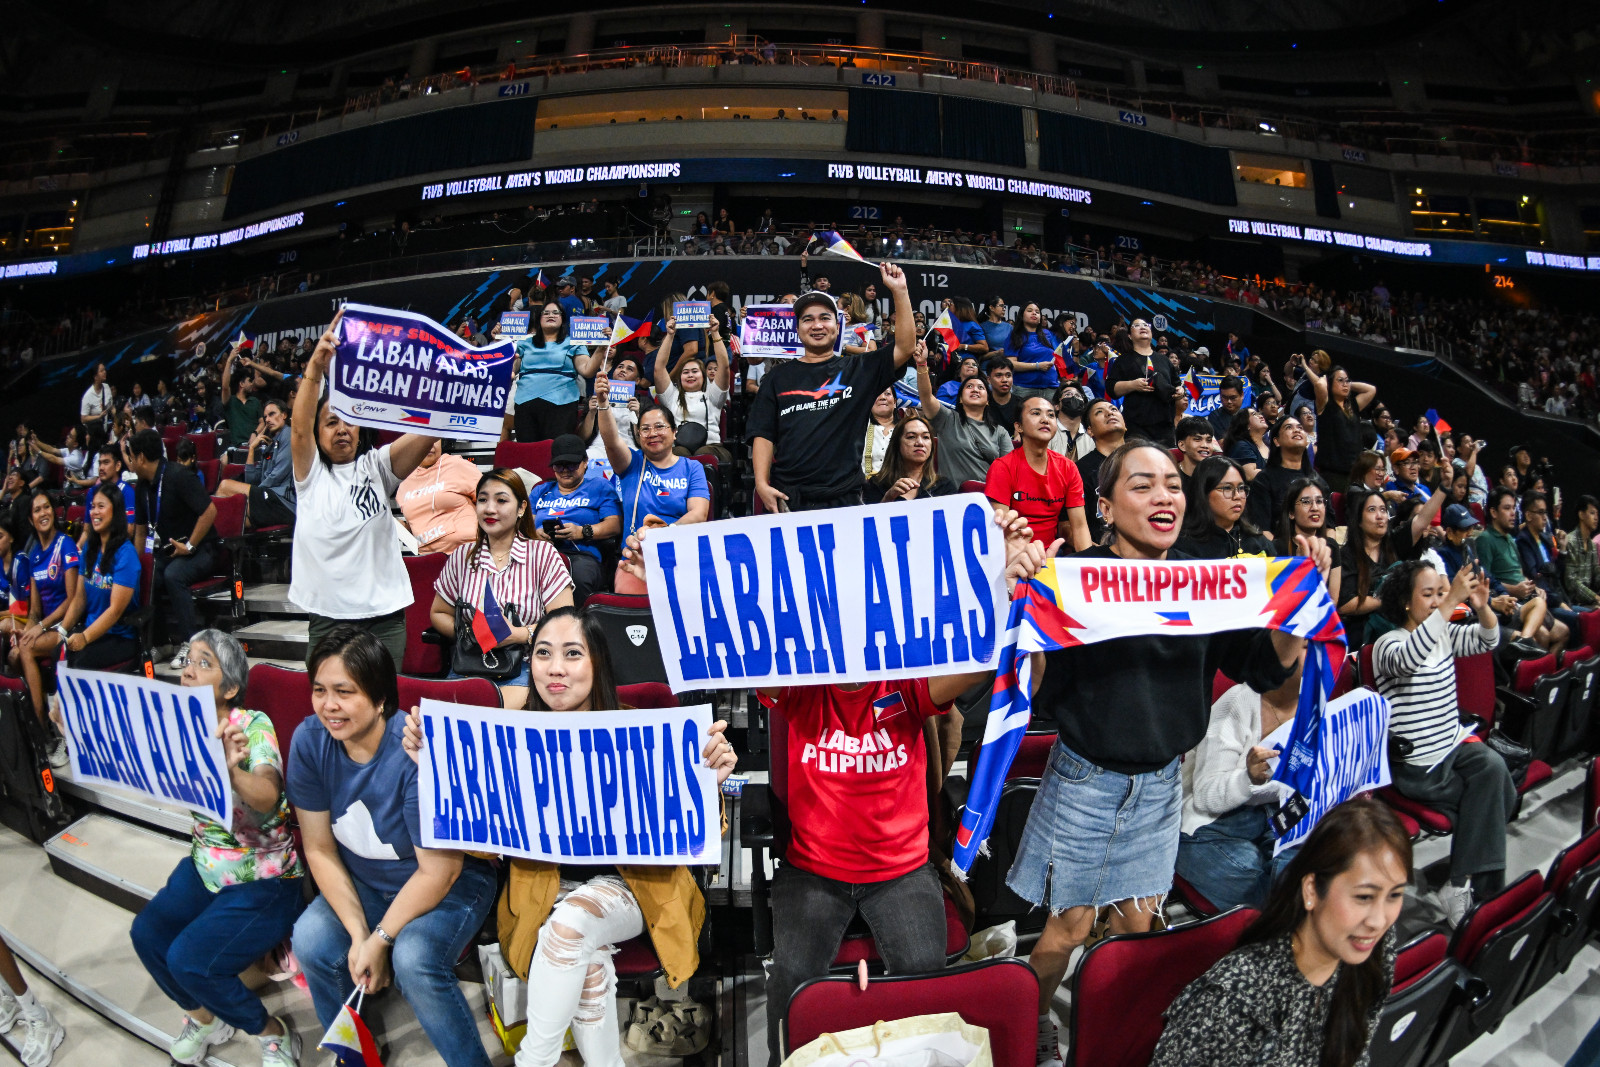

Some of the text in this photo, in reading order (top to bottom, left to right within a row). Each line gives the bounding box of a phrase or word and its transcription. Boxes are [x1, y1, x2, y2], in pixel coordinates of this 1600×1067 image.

[503, 82, 525, 95] 411
[866, 74, 892, 86] 412
[1122, 112, 1144, 126] 413
[278, 131, 298, 145] 410
[422, 163, 681, 200] FIVB VOLLEYBALL MEN'S WORLD CHAMPIONSHIPS
[828, 164, 1092, 204] FIVB VOLLEYBALL MEN'S WORLD CHAMPIONSHIPS
[851, 206, 879, 219] 212
[192, 235, 219, 250] MEN'S
[220, 228, 244, 245] WORLD
[244, 212, 304, 239] CHAMPIONSHIPS
[1228, 219, 1432, 257] FIVB VOLLEYBALL MEN'S WORLD CHAMPIONSHIPS
[1118, 235, 1139, 250] 213
[279, 250, 297, 264] 210
[920, 273, 949, 288] 112
[1494, 275, 1515, 288] 214
[755, 318, 794, 330] LABAN
[750, 331, 785, 343] LABAN
[356, 337, 433, 371] LABAN
[436, 355, 493, 383] ALAS,
[342, 365, 506, 409] LABAN PILIPINAS
[842, 386, 853, 399] 12
[363, 405, 388, 413] PNVF
[780, 405, 796, 417] DON'T
[796, 401, 817, 411] BLAME
[817, 399, 829, 407] THE
[1190, 394, 1223, 412] ALAS
[450, 415, 478, 426] FIVB
[403, 481, 445, 501] ACTION
[656, 503, 996, 681] LABAN ALAS
[1080, 564, 1248, 603] PHILIPPINES
[57, 675, 226, 820] LABAN ALAS
[818, 728, 893, 753] LABAN
[801, 743, 908, 774] PLIPINAS
[423, 714, 706, 859] LABAN PILIPINAS
